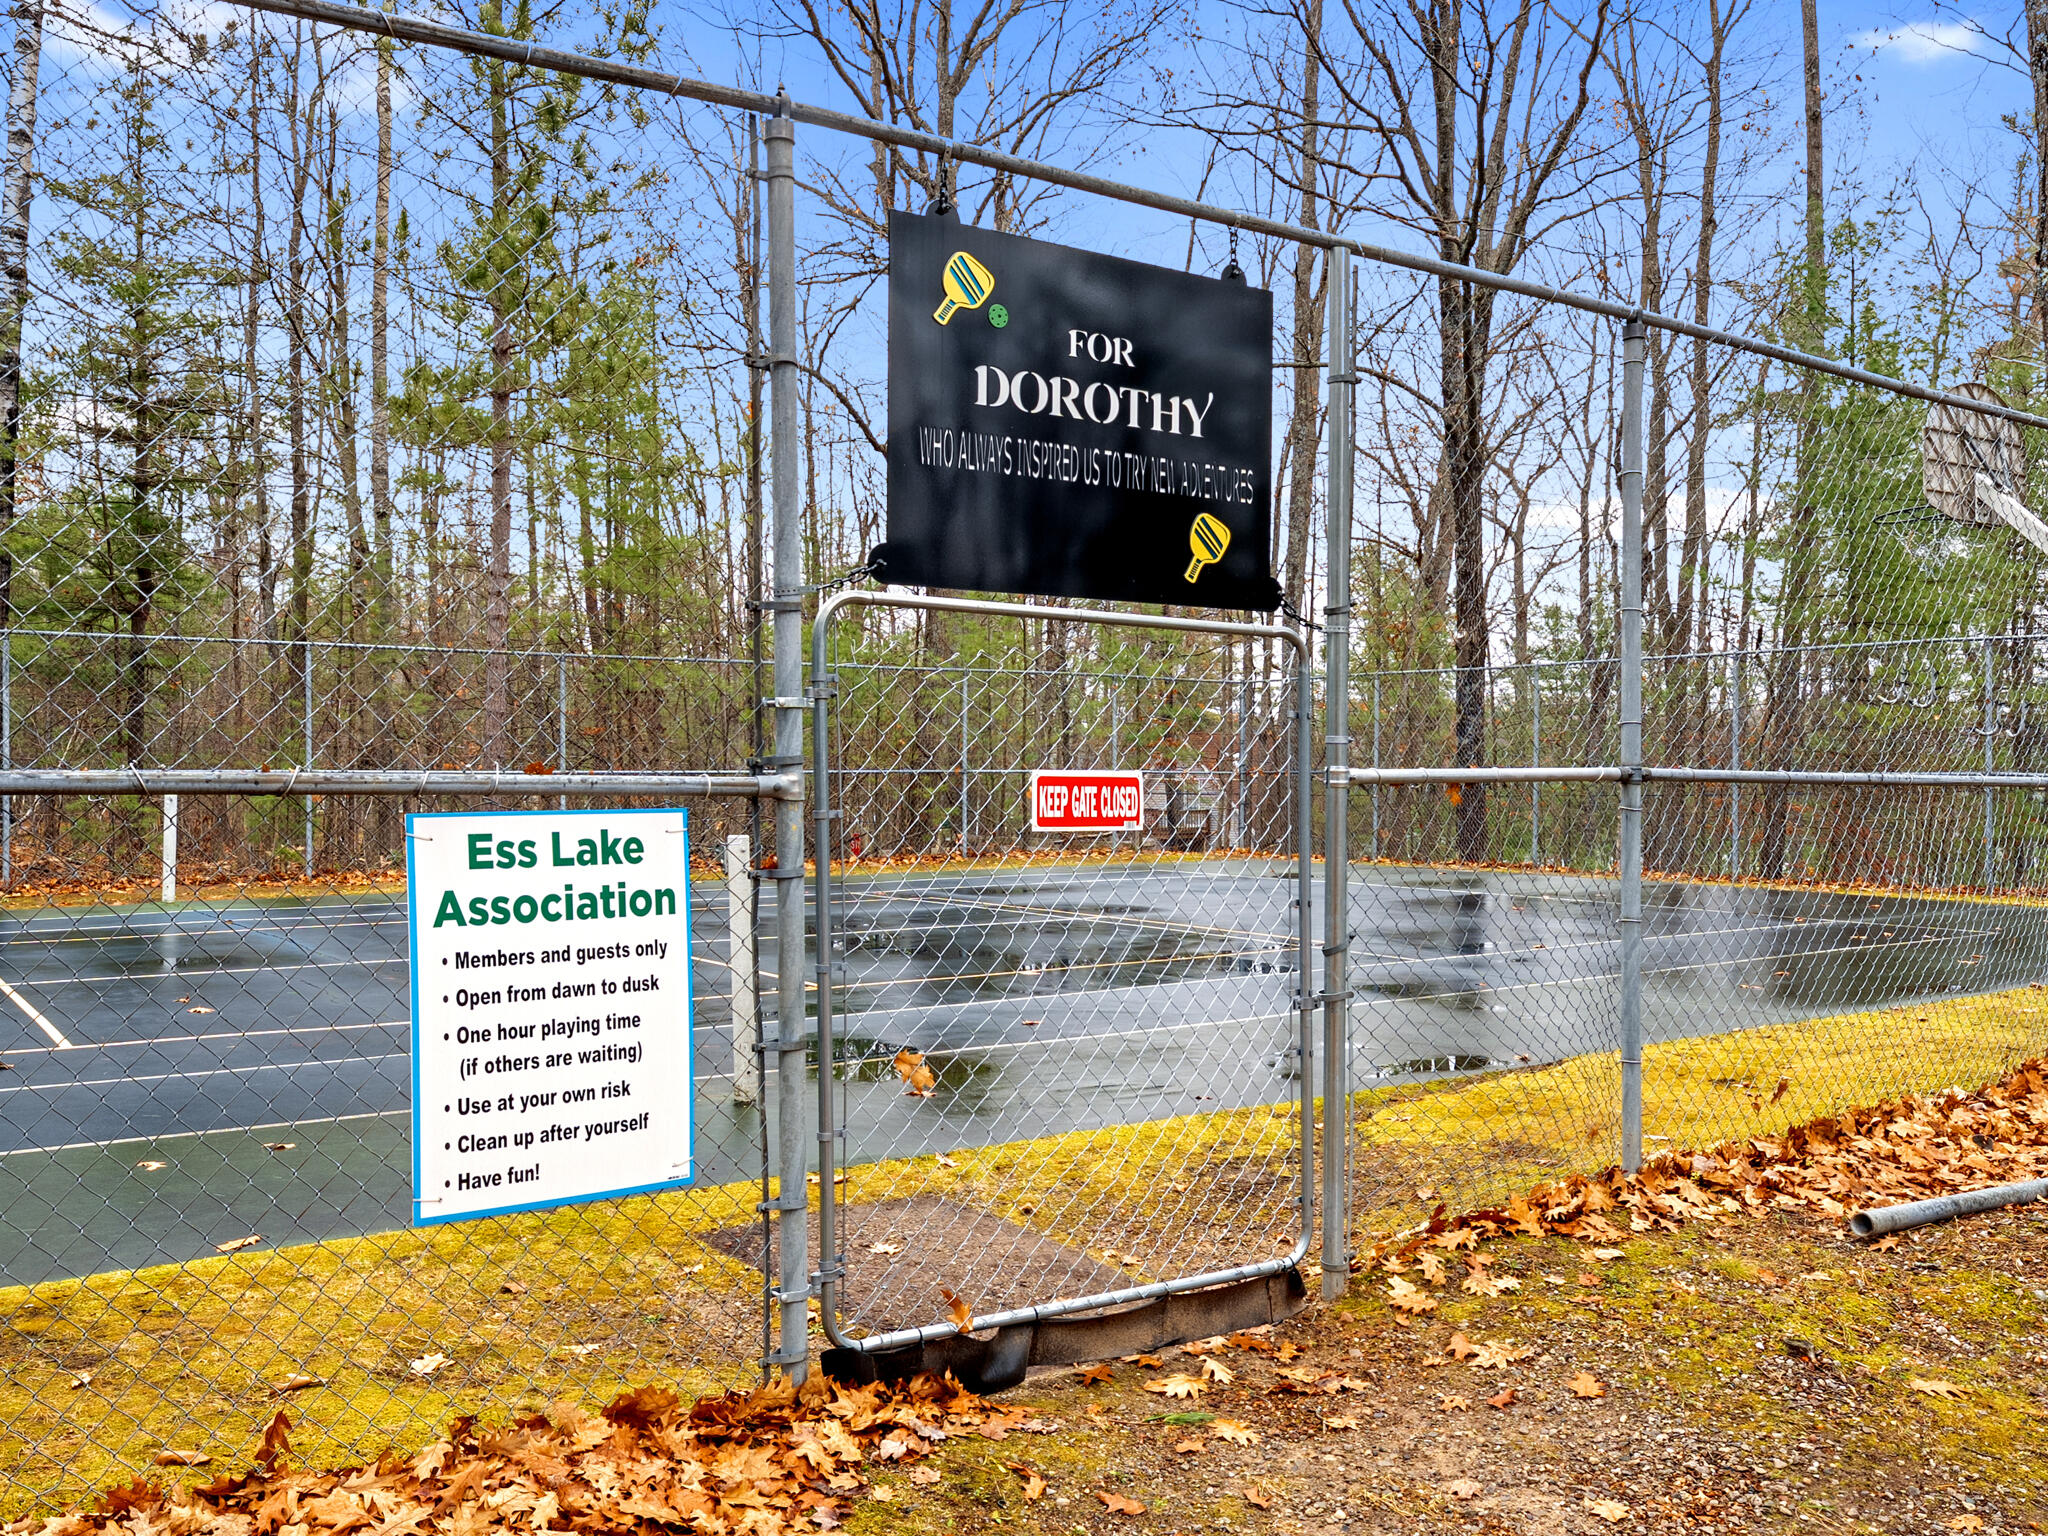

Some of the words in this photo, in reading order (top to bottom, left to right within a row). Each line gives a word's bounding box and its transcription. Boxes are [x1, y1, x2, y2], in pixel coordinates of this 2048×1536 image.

[1069, 330, 1134, 367] FOR
[974, 364, 1214, 438] DOROTHY
[920, 427, 953, 467] WHO
[958, 432, 1012, 475] ALWAYS
[1018, 439, 1078, 482] INSPIRED
[1084, 448, 1100, 485] US
[1105, 450, 1121, 487] TO
[1125, 453, 1146, 489] TRY
[1040, 785, 1069, 818] KEEP
[1072, 786, 1097, 817] GATE
[1101, 785, 1139, 818] CLOSED
[468, 834, 537, 869] Ess
[552, 829, 644, 866] Lake
[433, 882, 675, 928] Association
[456, 950, 535, 969] Members
[541, 945, 570, 963] and
[577, 943, 630, 965] guests
[636, 939, 667, 959] only
[456, 989, 501, 1010] Open
[507, 985, 546, 1002] from
[552, 982, 595, 999] dawn
[601, 979, 617, 994] to
[623, 974, 659, 993] dusk
[457, 1027, 491, 1044] One
[498, 1024, 536, 1040] hour
[542, 1017, 600, 1041] playing
[606, 1013, 640, 1030] time
[461, 1058, 478, 1081] (if
[485, 1055, 539, 1073] others
[546, 1053, 572, 1067] are
[578, 1041, 642, 1063] waiting)
[458, 1098, 491, 1115] Use
[498, 1094, 514, 1111] at
[520, 1092, 557, 1113] your
[563, 1088, 595, 1103] own
[602, 1080, 630, 1098] risk
[458, 1135, 507, 1153] Clean
[514, 1132, 534, 1149] up
[540, 1124, 580, 1143] after
[585, 1112, 649, 1141] yourself
[459, 1173, 501, 1190] Have
[508, 1163, 539, 1184] fun!
